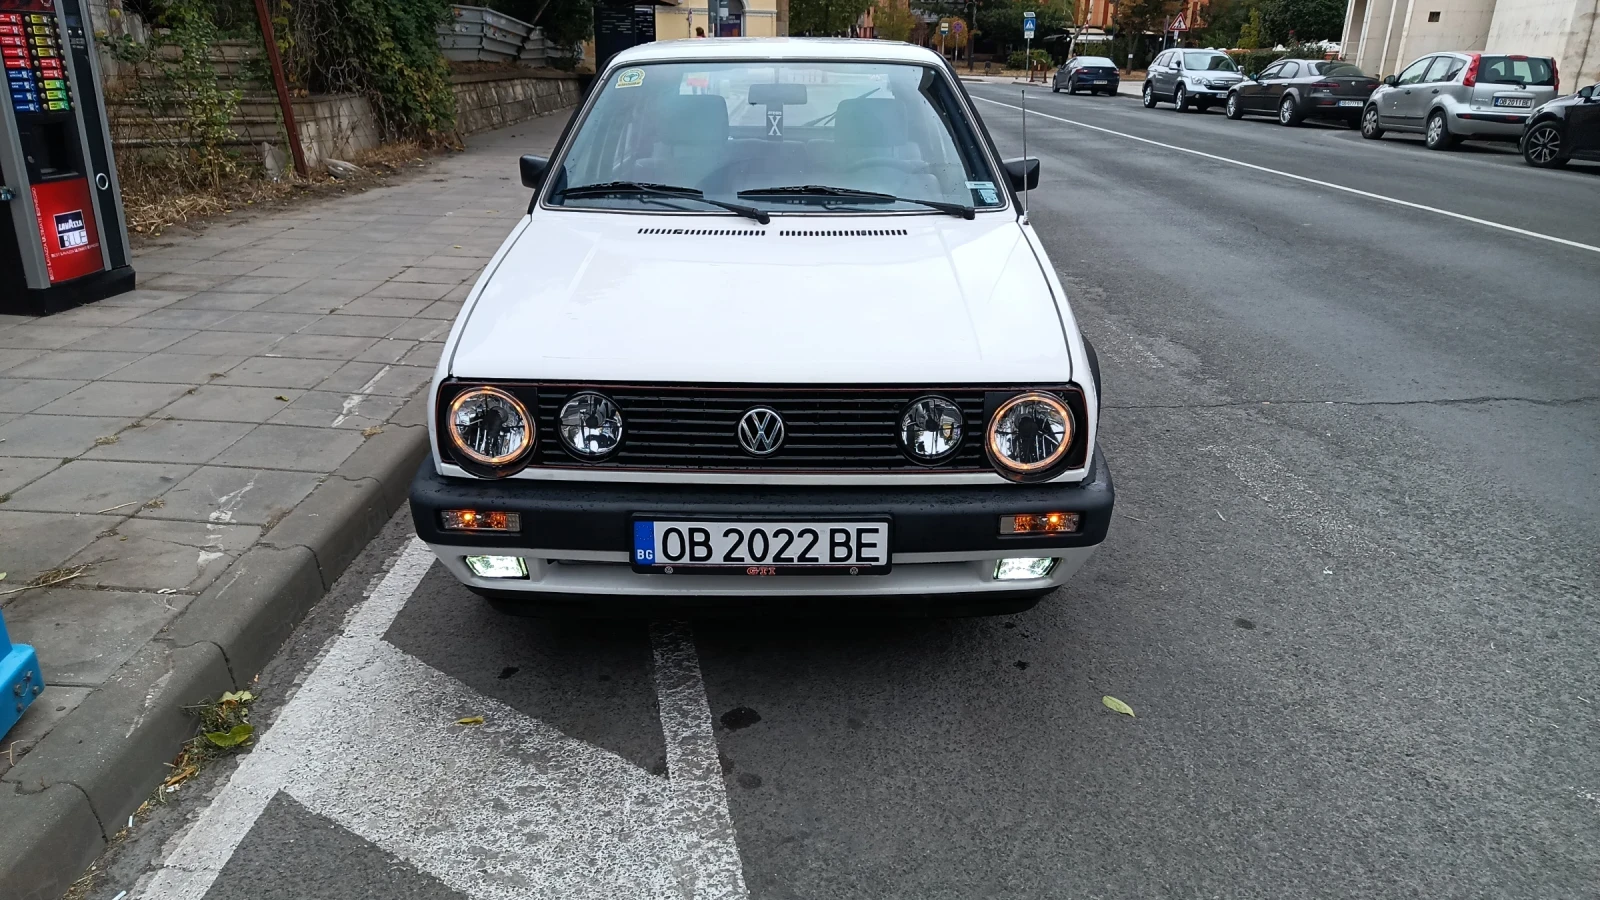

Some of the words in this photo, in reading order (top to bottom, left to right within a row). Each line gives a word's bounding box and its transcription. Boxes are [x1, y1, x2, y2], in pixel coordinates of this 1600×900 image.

[58, 219, 83, 231] LAVAZZA
[661, 527, 713, 563] OB
[722, 528, 819, 563] 2022
[829, 528, 880, 563] BE
[637, 549, 653, 560] BG
[747, 566, 776, 576] GTI
